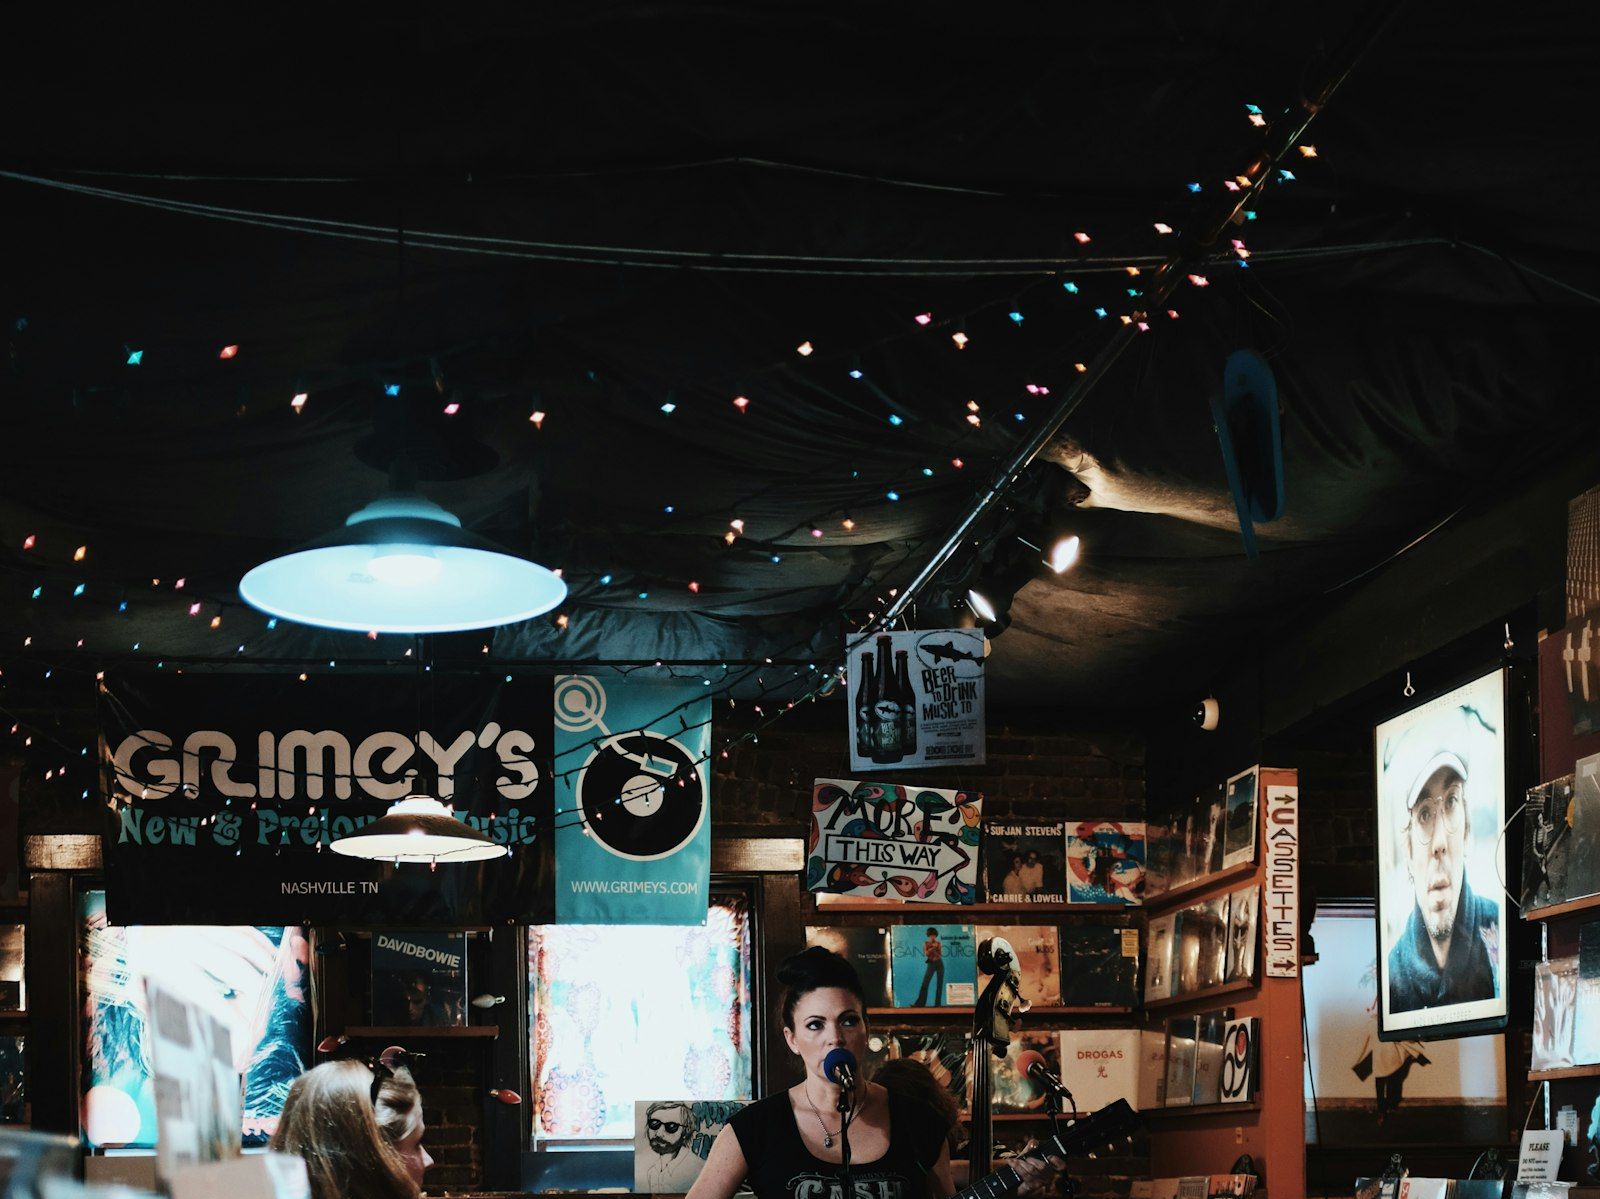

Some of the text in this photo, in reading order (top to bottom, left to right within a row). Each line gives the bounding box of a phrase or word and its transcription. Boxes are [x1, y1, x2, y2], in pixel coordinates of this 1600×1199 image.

[961, 700, 972, 714] TO
[823, 796, 948, 842] MORE
[117, 807, 200, 845] New
[212, 810, 243, 846] &
[990, 825, 1062, 837] SUFJAN STEVENS
[836, 839, 942, 868] THIS WAY
[1270, 807, 1297, 952] CASSETTES
[281, 881, 379, 894] NASHVILLE TN
[571, 880, 698, 895] WWW.GRIMEYS.COM
[992, 893, 1064, 904] CARRIE & LOWELL
[1077, 1050, 1124, 1060] DROGAS
[1529, 1142, 1550, 1152] PLEASE
